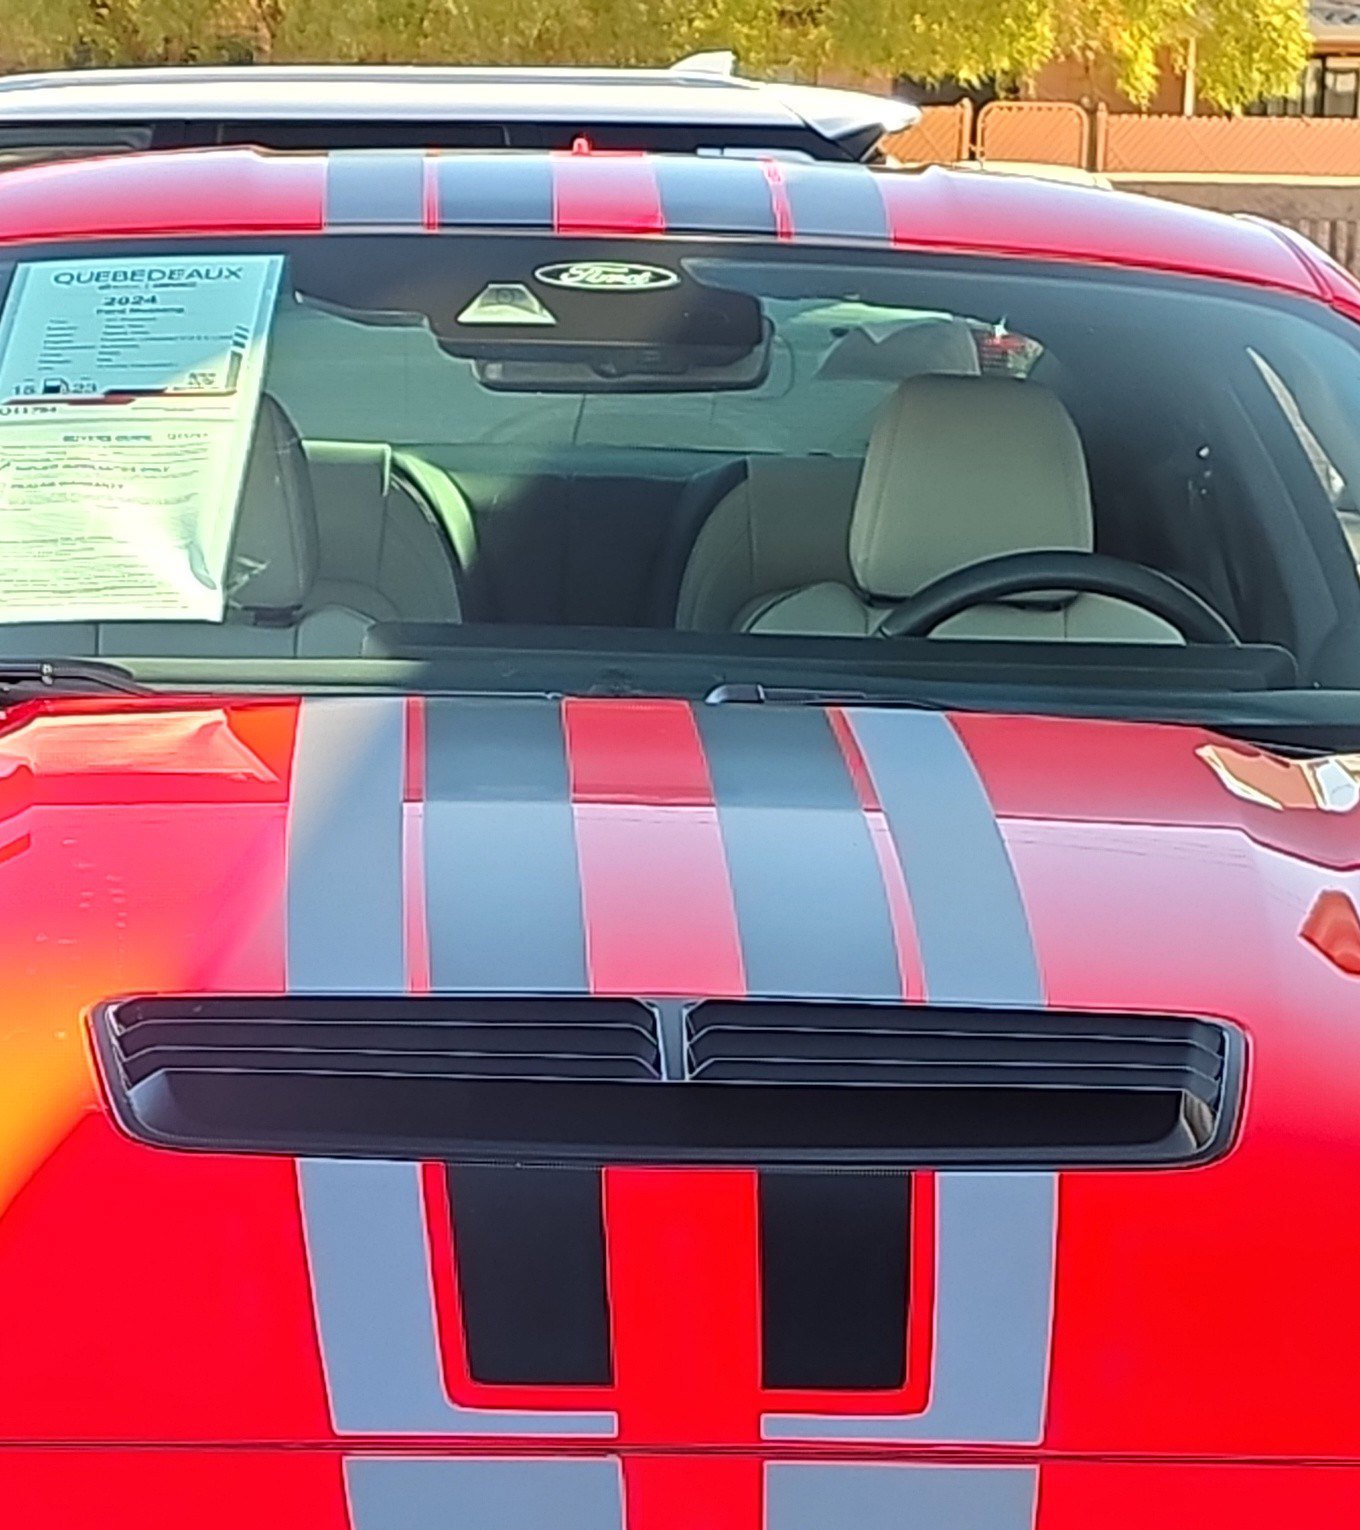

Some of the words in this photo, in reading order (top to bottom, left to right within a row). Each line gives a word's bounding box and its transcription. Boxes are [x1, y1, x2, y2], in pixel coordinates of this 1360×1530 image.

[54, 267, 243, 285] QUEBEDEAUX
[559, 265, 653, 285] Ford
[103, 295, 157, 306] 2024
